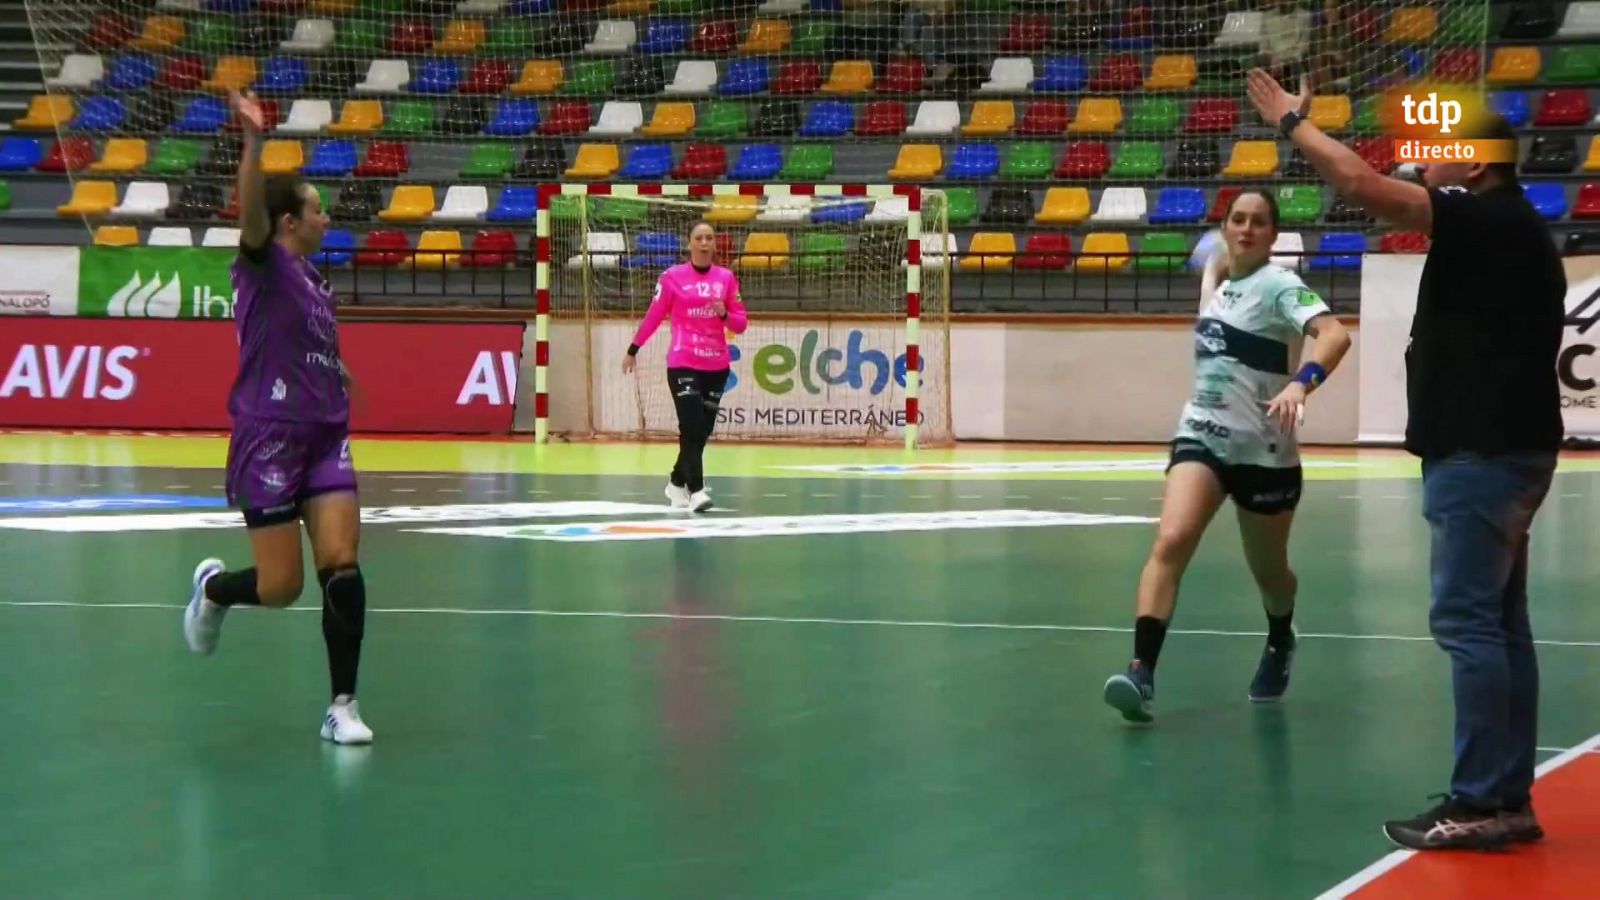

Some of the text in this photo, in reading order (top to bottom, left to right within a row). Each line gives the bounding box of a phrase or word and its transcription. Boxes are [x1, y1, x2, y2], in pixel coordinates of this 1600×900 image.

[694, 282, 711, 297] 12
[753, 329, 924, 395] elche
[0, 344, 138, 400] AVIS
[1560, 395, 1597, 408] OME
[715, 407, 745, 424] SIS
